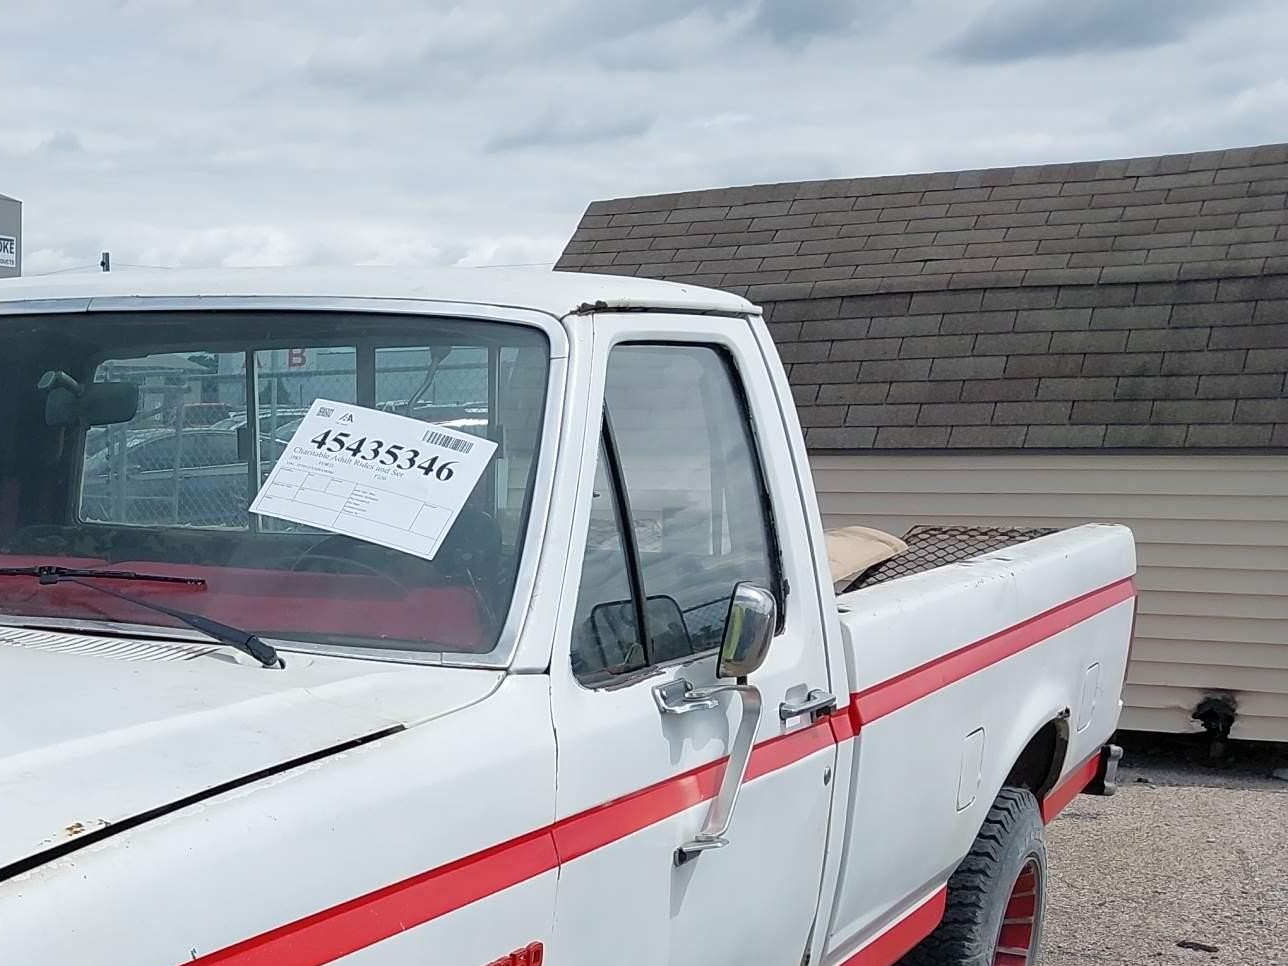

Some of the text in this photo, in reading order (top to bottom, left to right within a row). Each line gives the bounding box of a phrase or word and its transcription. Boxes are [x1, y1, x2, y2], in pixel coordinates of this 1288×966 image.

[288, 348, 307, 368] B
[293, 446, 404, 478] Charitable Adult Rides and Ser
[311, 429, 461, 481] 45435346
